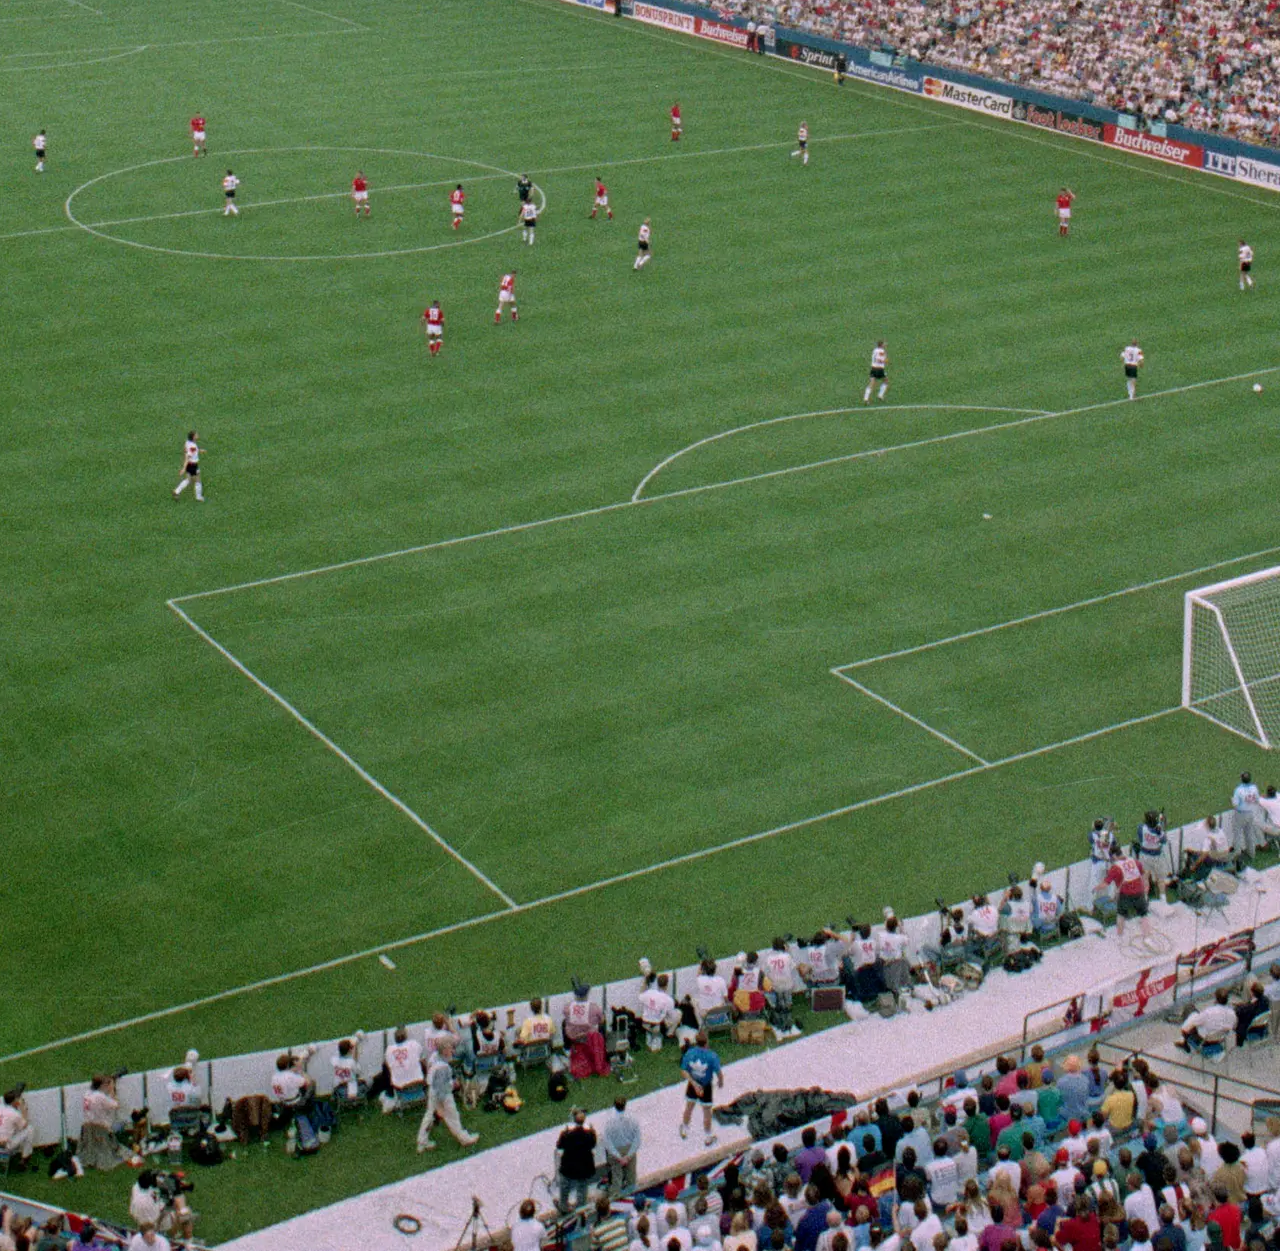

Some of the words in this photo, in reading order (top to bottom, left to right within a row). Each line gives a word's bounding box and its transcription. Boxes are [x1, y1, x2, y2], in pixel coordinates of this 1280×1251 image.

[635, 4, 692, 30] BONUSPRINT
[700, 18, 748, 44] Budweiser
[799, 47, 834, 65] Sprint
[943, 84, 1011, 114] MasterCard
[1113, 127, 1190, 162] Budweiser
[1206, 151, 1237, 174] ITT
